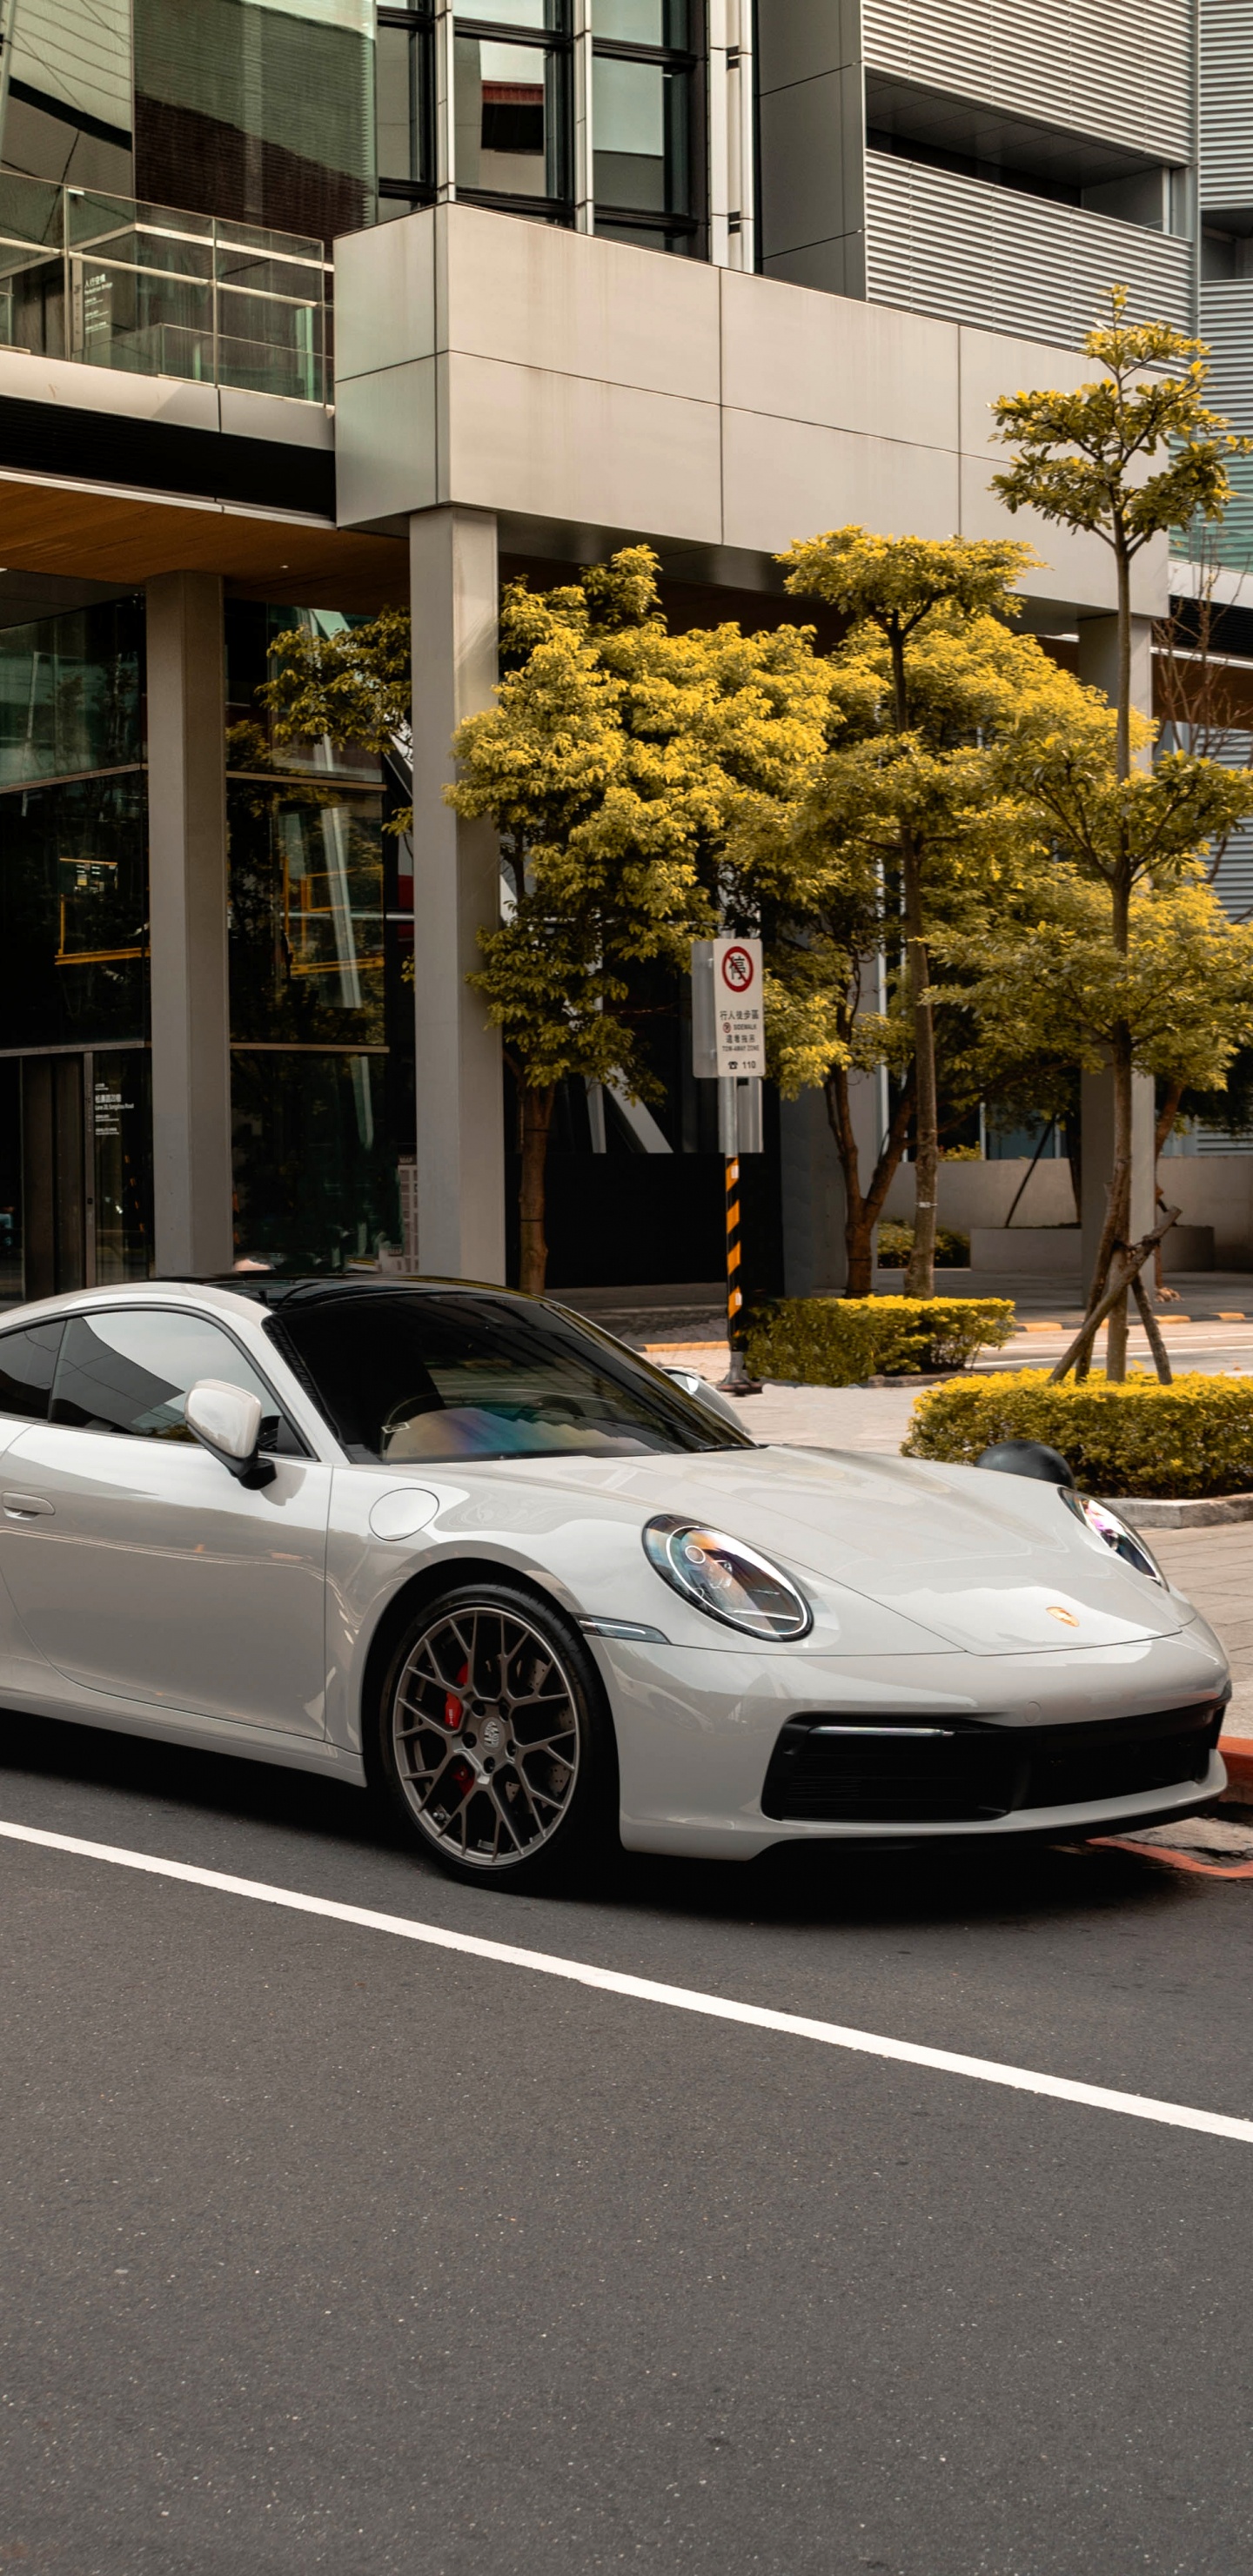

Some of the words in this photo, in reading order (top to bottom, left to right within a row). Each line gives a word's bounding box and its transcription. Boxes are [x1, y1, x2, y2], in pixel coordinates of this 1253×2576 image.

[728, 956, 746, 980] 停
[720, 1010, 759, 1021] 行人徒步區
[742, 1060, 756, 1069] 110
